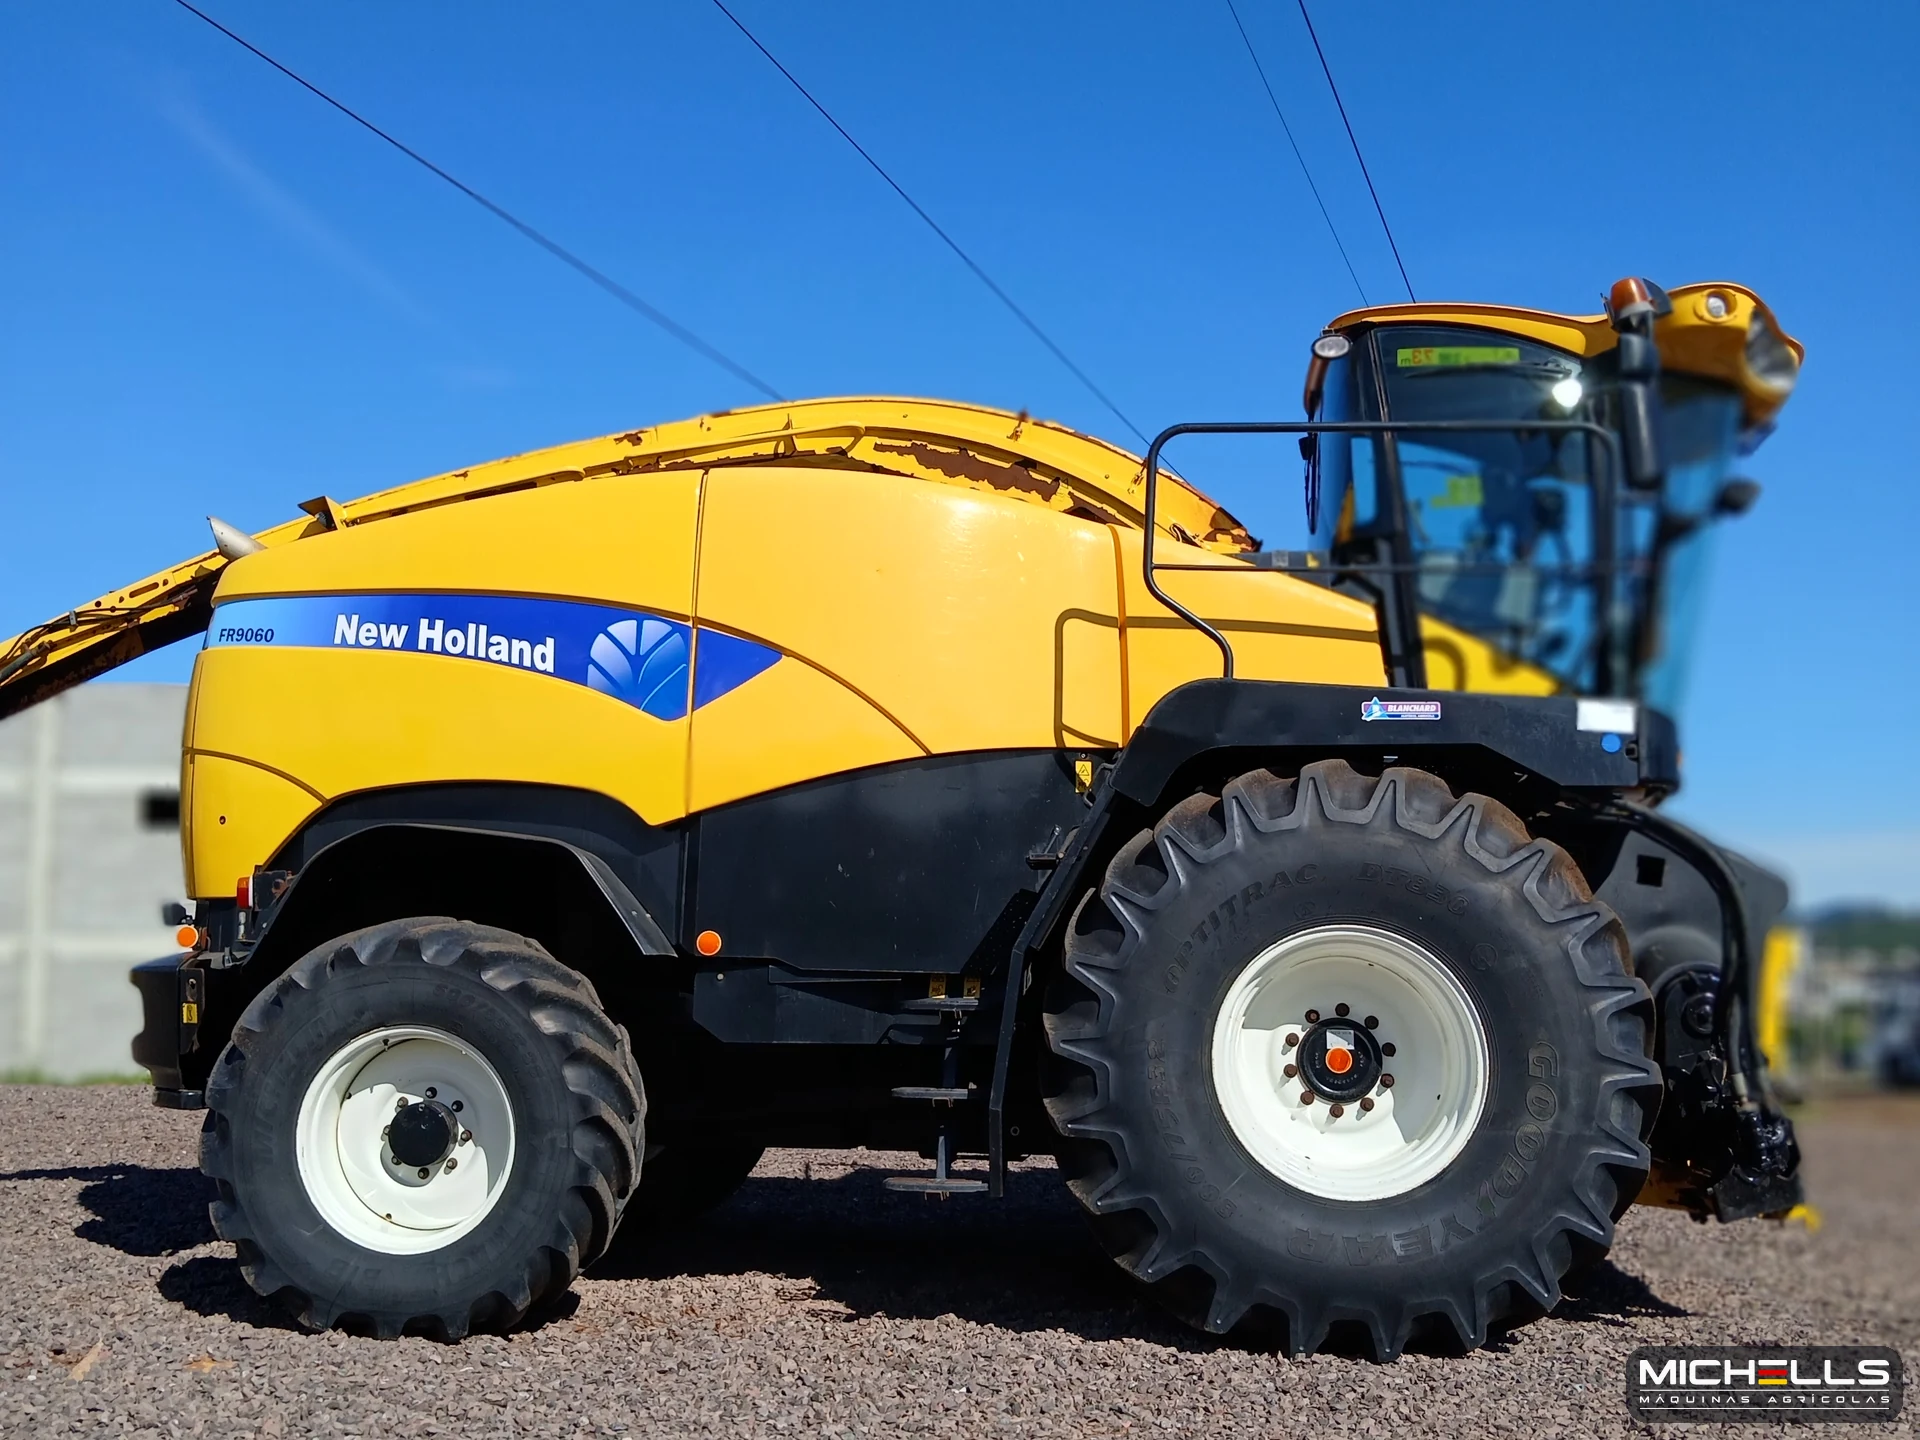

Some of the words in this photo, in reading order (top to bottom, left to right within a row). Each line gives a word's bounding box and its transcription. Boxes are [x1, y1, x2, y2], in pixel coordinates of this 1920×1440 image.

[218, 627, 275, 644] FR9060
[333, 613, 408, 649] New
[418, 618, 556, 673] Holland
[1387, 704, 1437, 712] BLANCHARD
[1162, 863, 1320, 994] OPTITRAC
[1286, 1040, 1560, 1266] GOODYEAR
